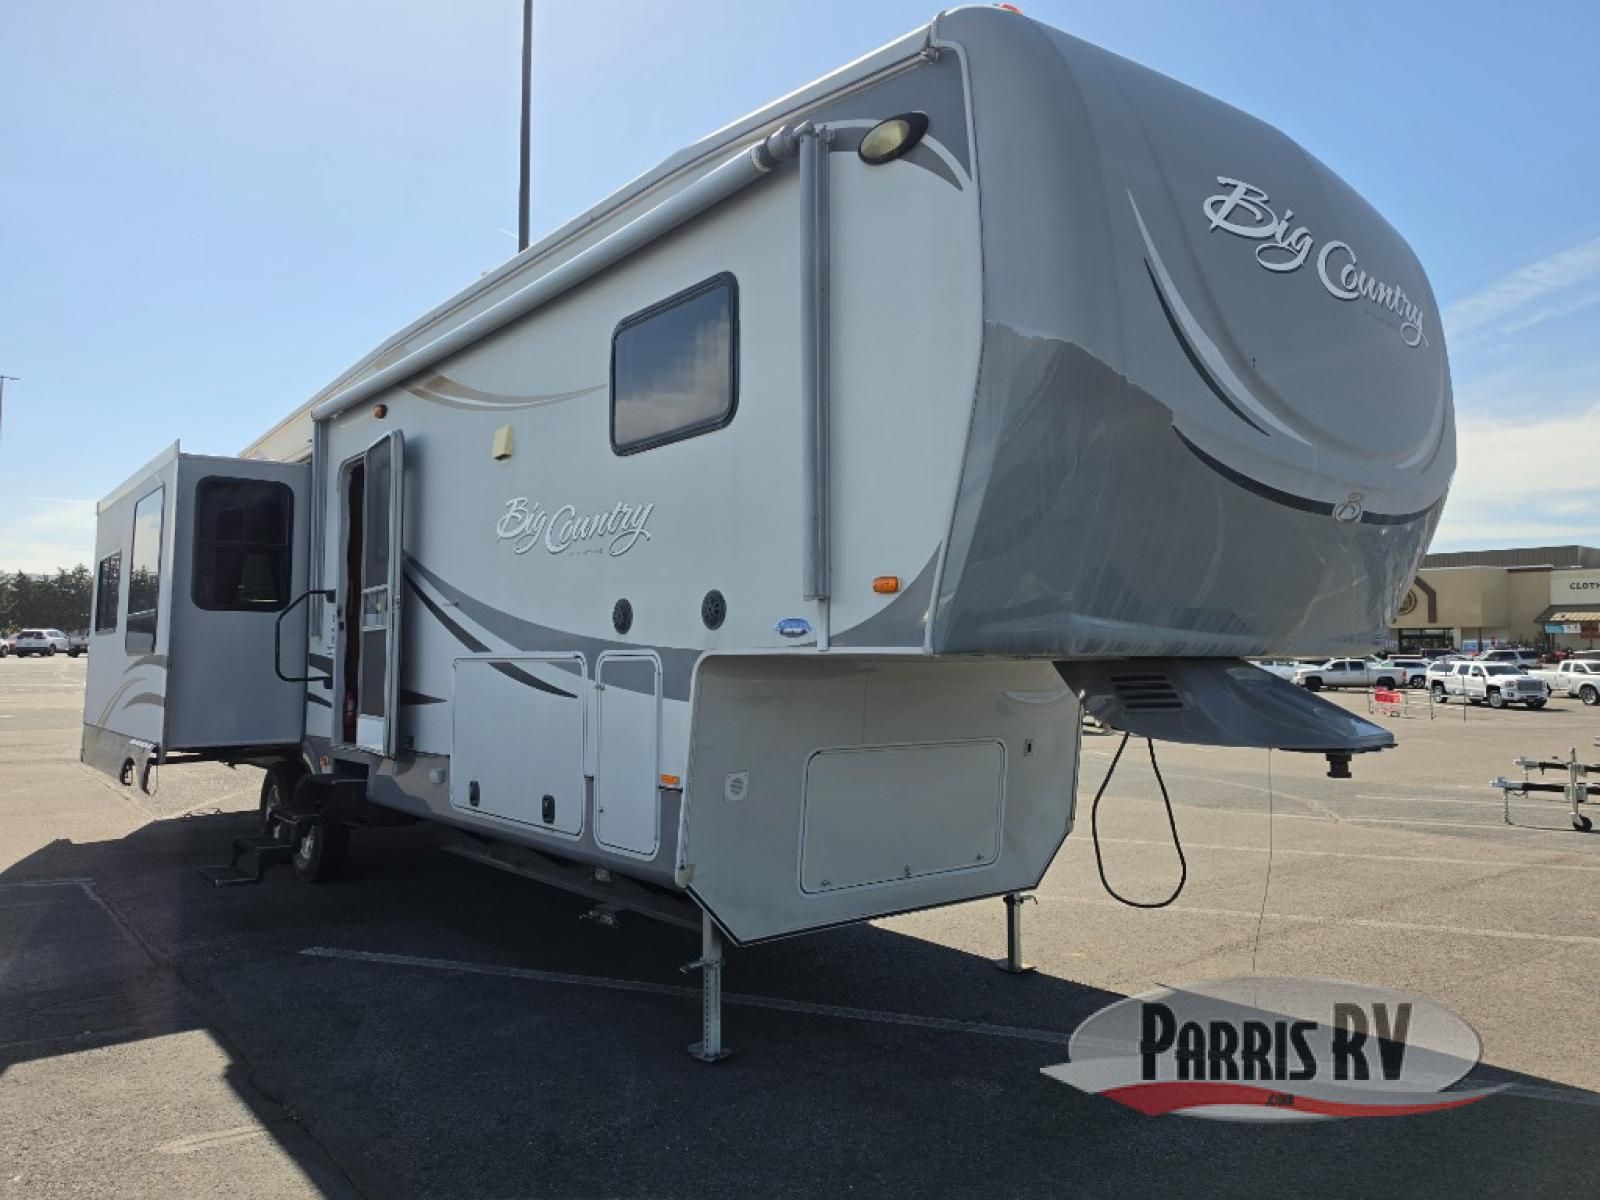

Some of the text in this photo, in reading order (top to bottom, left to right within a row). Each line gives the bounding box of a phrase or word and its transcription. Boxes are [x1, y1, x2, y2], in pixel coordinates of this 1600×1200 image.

[1203, 176, 1428, 348] Big Country
[496, 496, 655, 557] Big Country
